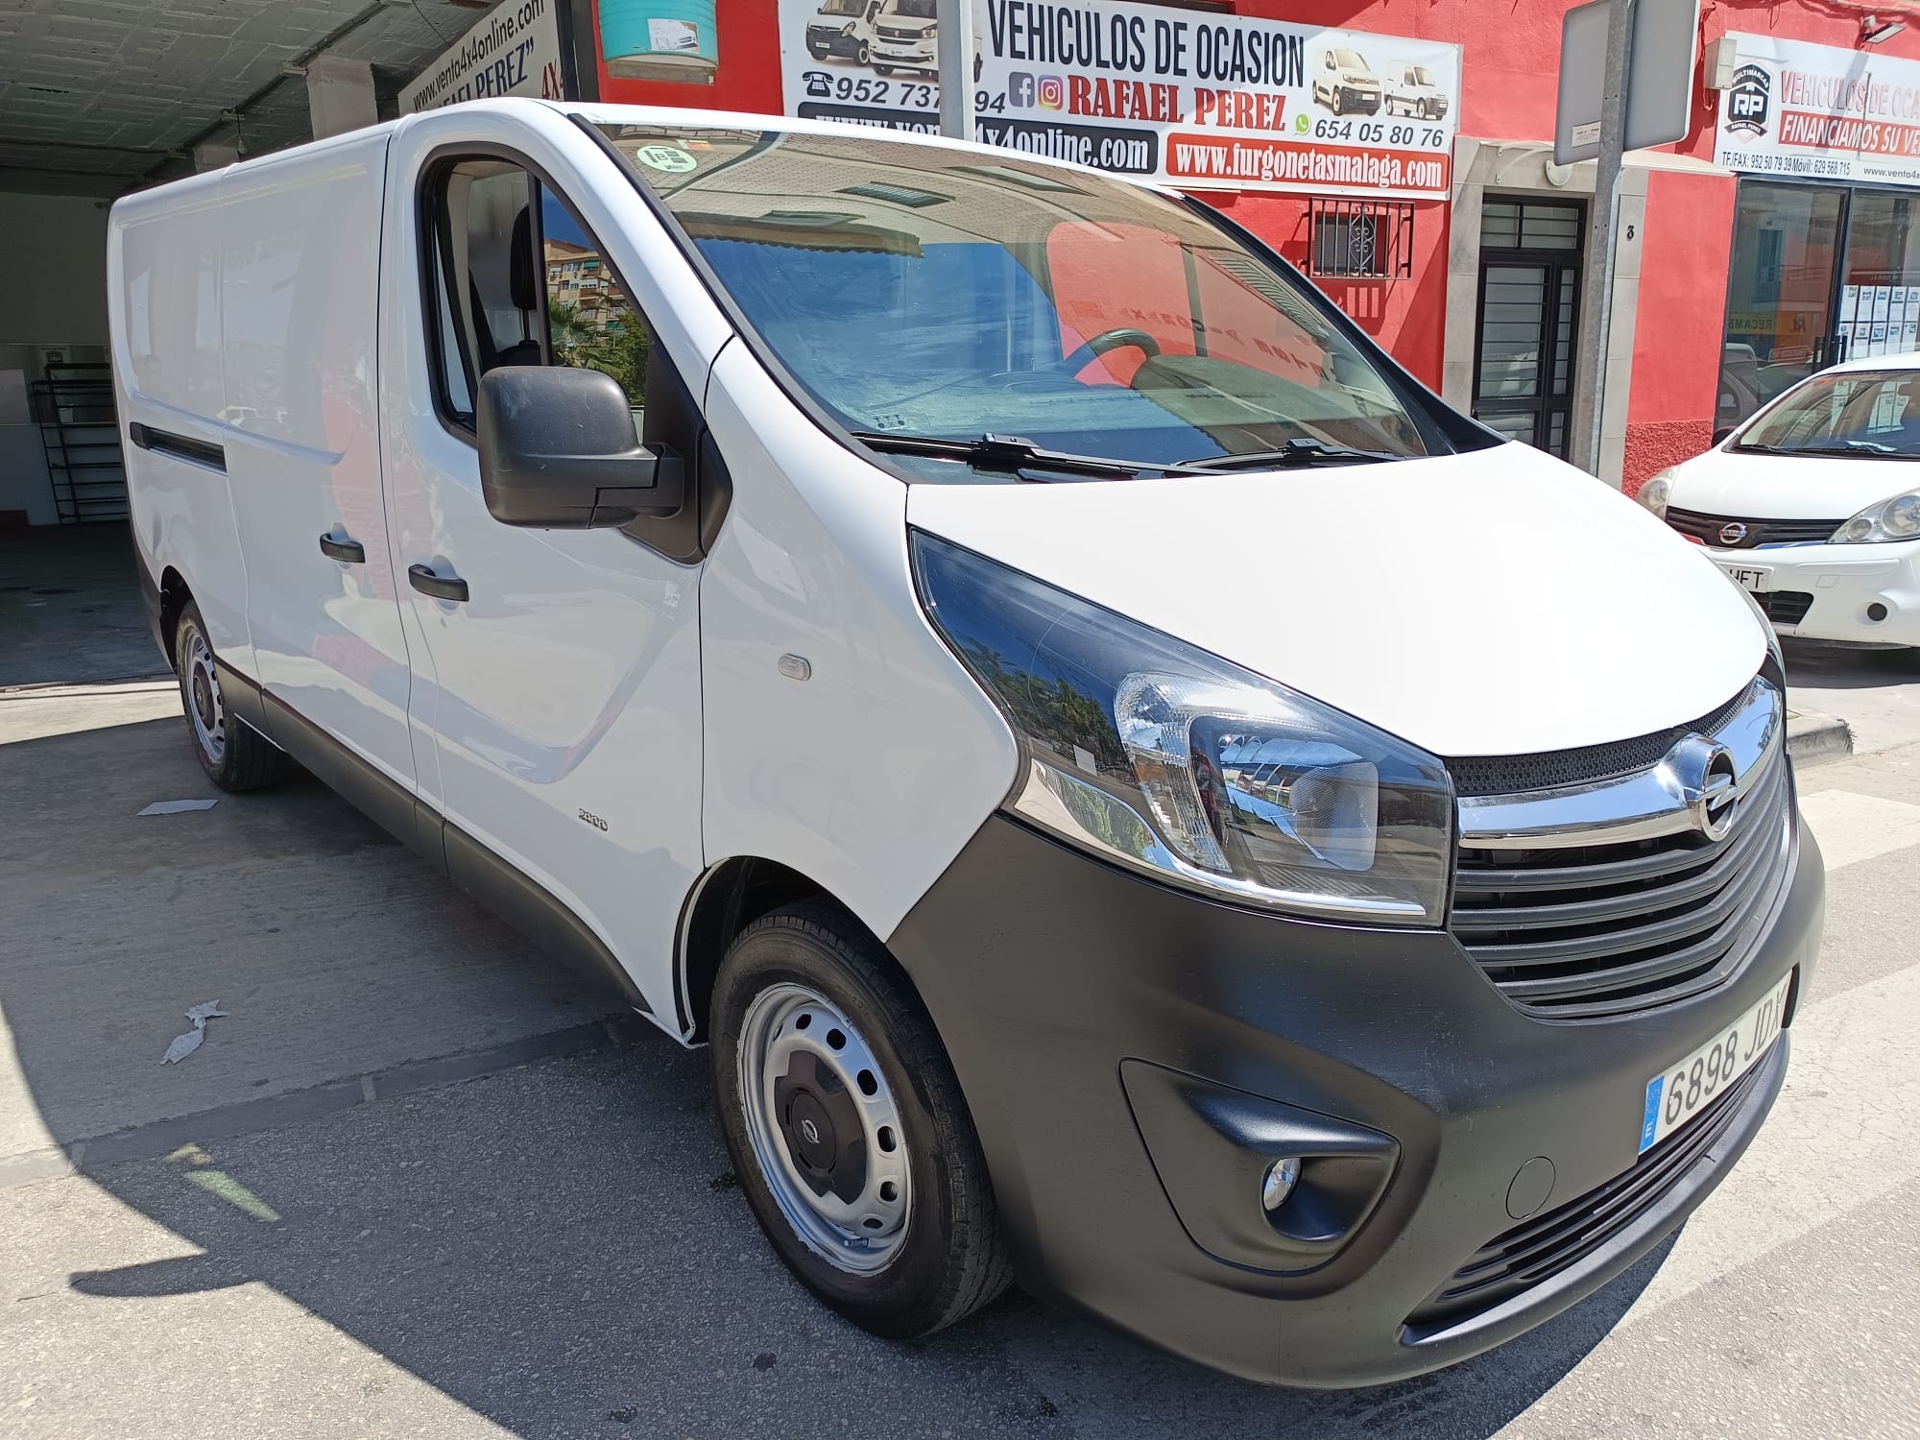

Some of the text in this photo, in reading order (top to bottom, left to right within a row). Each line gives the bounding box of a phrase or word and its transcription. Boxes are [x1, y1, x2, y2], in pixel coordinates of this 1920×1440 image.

[987, 1, 1304, 88] VEHICULOS DE OCASION
[835, 77, 890, 104] 952
[974, 90, 1006, 114] 94
[1068, 74, 1286, 131] RAFAEL PEREZ
[1734, 93, 1764, 116] RP
[1781, 70, 1867, 112] VEHICULOS
[1869, 83, 1890, 115] DE
[1315, 119, 1444, 147] 654 05 80 76
[1782, 114, 1881, 150] FINANCIAMOS
[1881, 126, 1902, 153] SU
[1176, 142, 1442, 188] www.furgonetasmalaga.com
[1774, 157, 1783, 170] 79
[1840, 162, 1851, 176] 715
[1665, 1030, 1738, 1125] 6898
